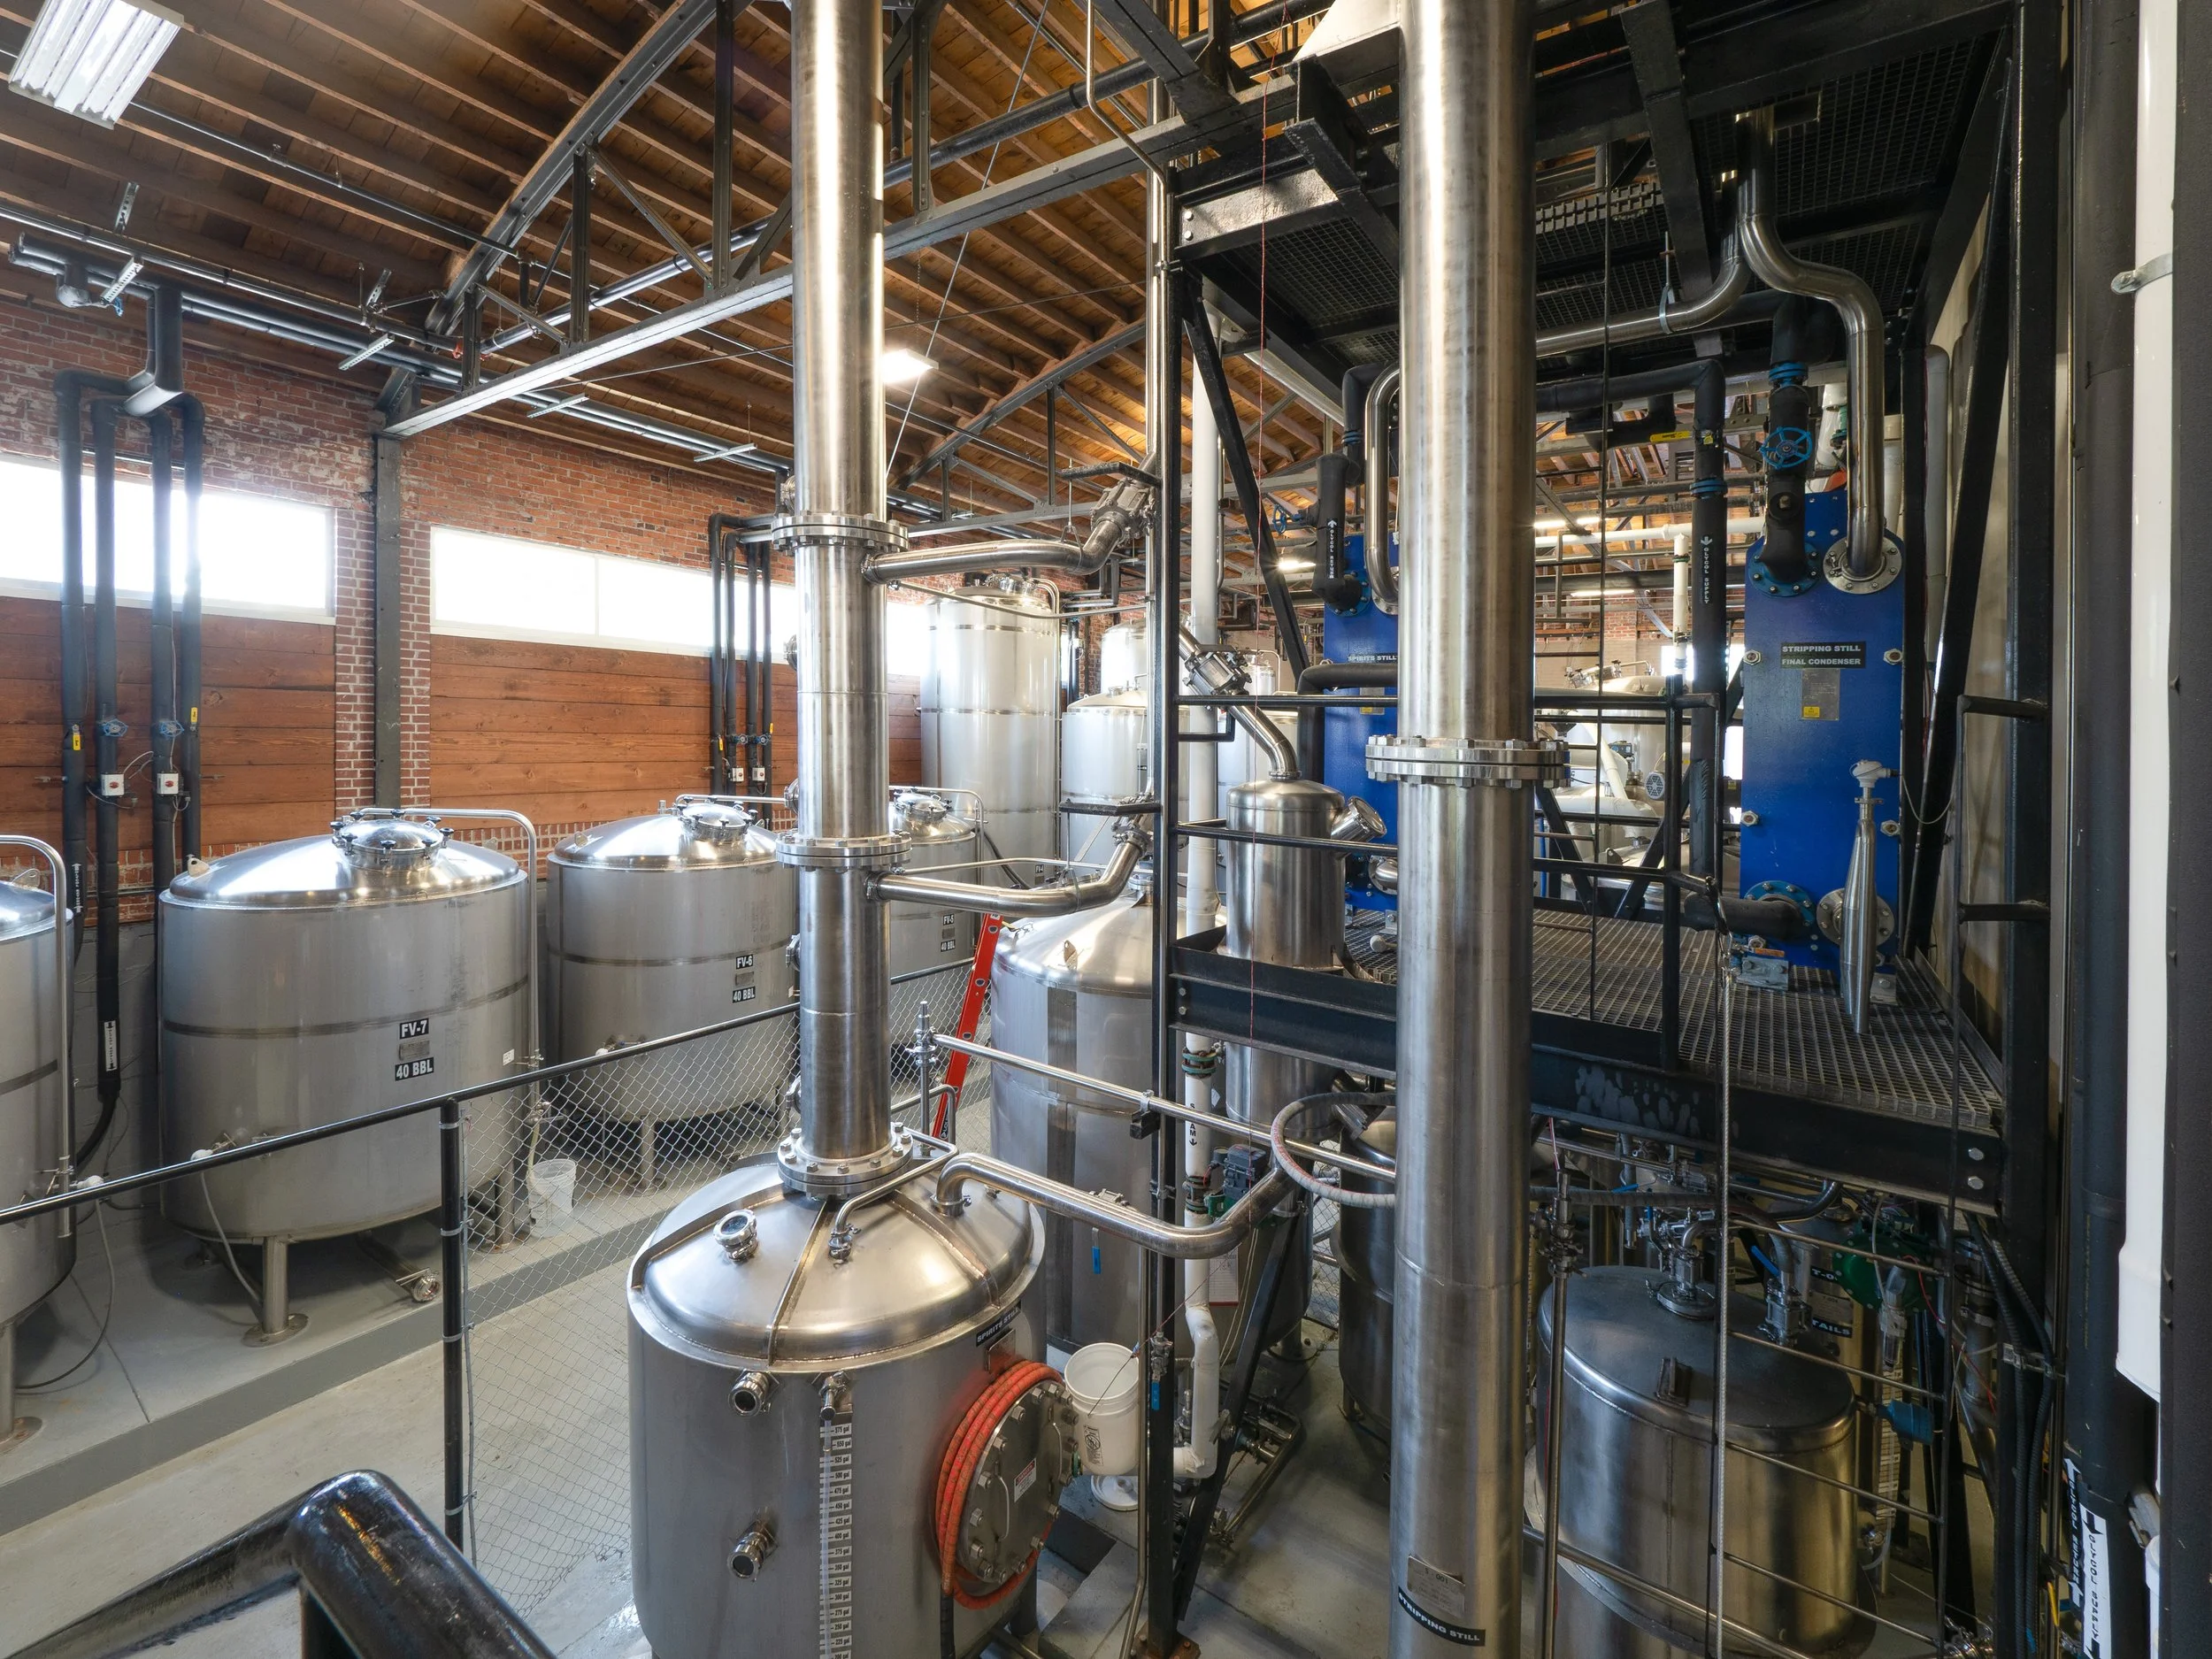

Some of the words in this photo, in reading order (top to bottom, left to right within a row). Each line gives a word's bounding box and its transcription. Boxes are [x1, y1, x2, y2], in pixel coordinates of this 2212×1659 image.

[943, 914, 954, 925] FV-5
[941, 942, 947, 951] 40
[737, 955, 753, 968] FV-6
[733, 991, 742, 1002] 40
[743, 987, 755, 1000] BBL
[401, 1020, 428, 1037] FV-7
[396, 1064, 409, 1079] 40
[412, 1060, 433, 1076] BBL
[977, 1320, 1003, 1343] SPIRITS
[1003, 1306, 1019, 1324] STILL
[1812, 1319, 1850, 1335] TAILS
[2089, 1535, 2097, 1585] GLYCOL
[1399, 1592, 1447, 1633] STRIPPING
[1449, 1630, 1480, 1641] STILL
[2091, 1592, 2099, 1640] SUPPLY
